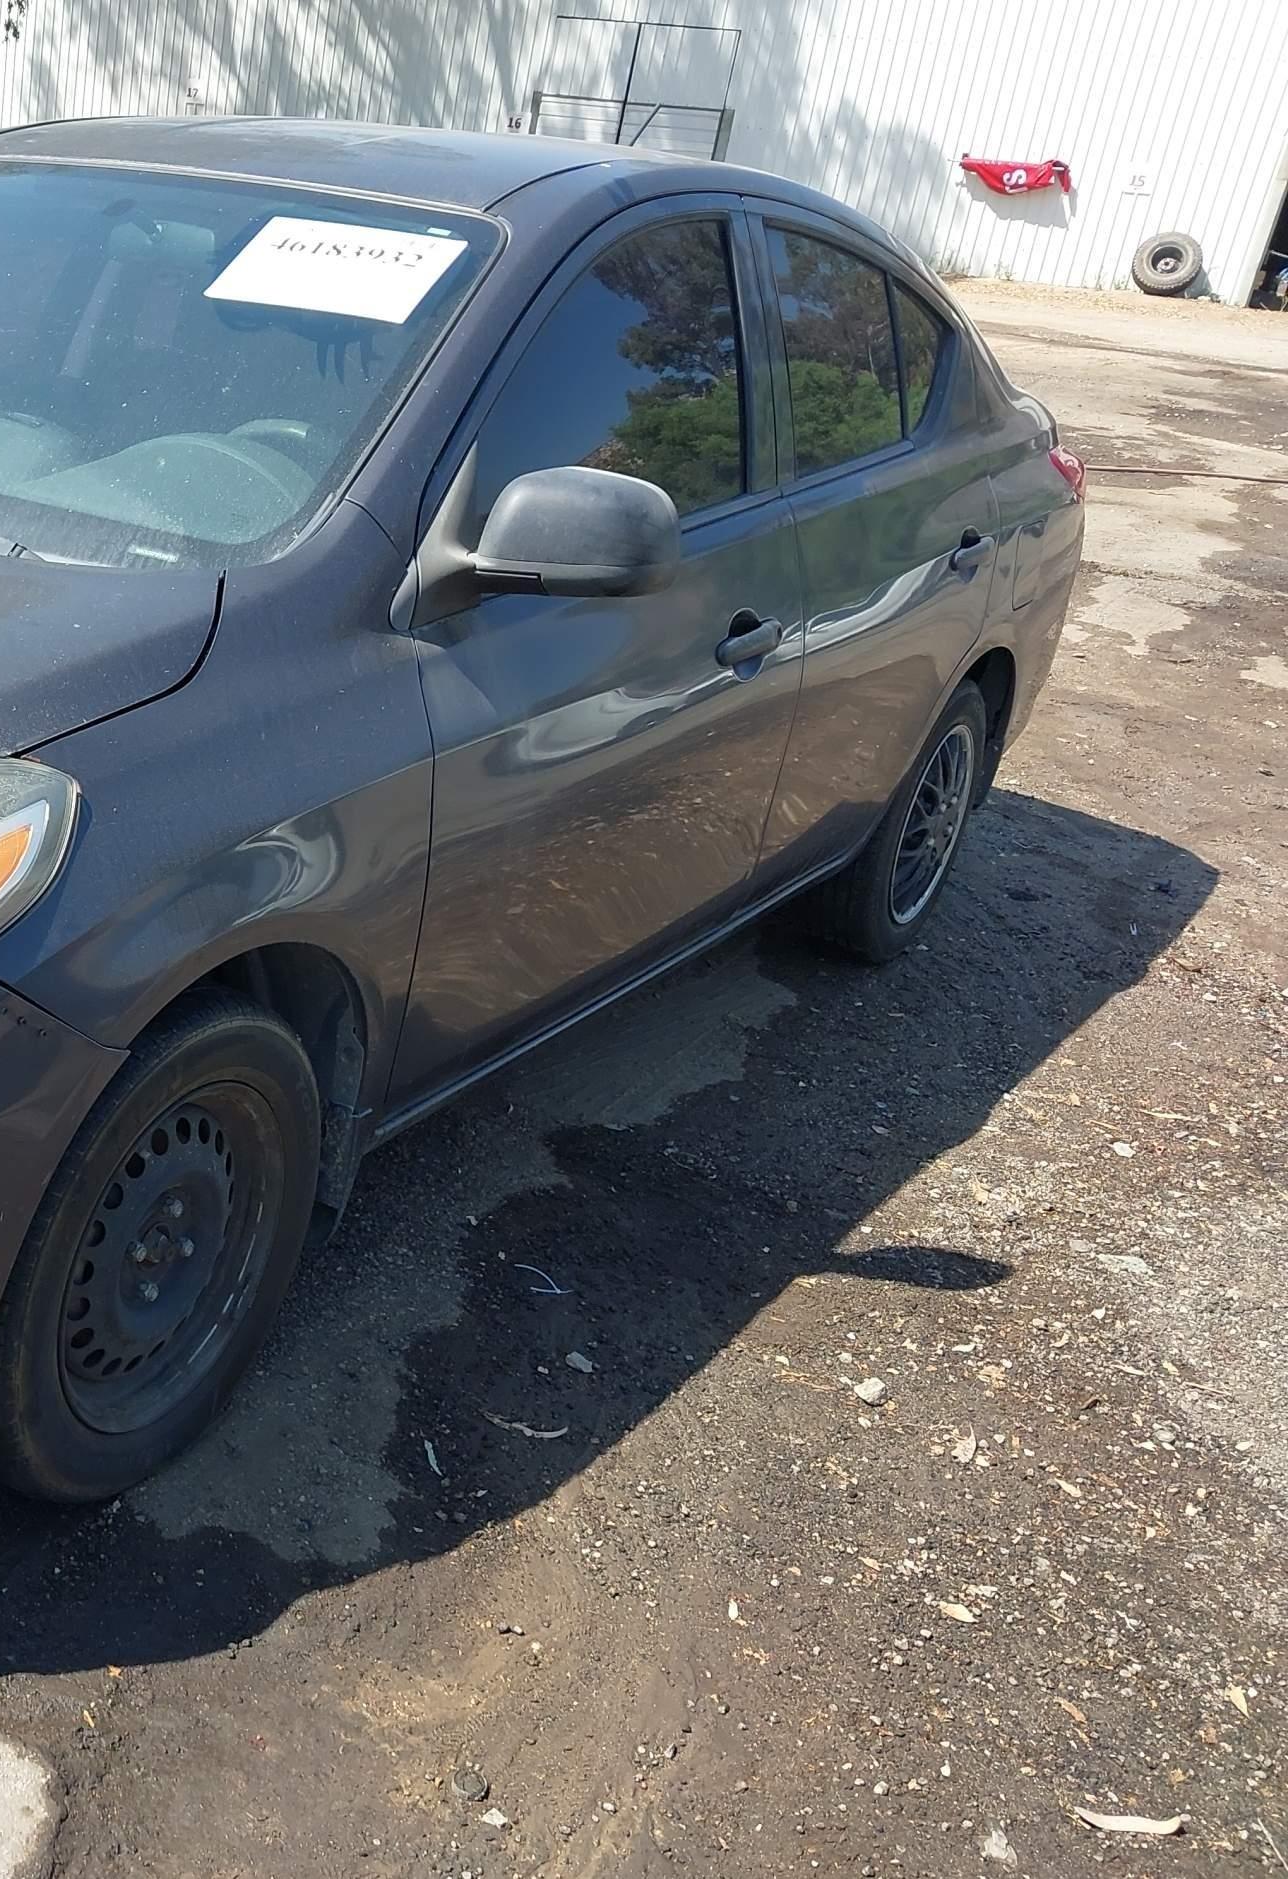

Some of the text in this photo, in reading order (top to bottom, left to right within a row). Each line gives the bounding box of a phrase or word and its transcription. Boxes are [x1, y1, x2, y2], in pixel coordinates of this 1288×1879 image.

[186, 87, 199, 98] 17
[507, 116, 523, 129] 16
[1128, 175, 1146, 187] 15
[270, 237, 423, 267] 46183932
